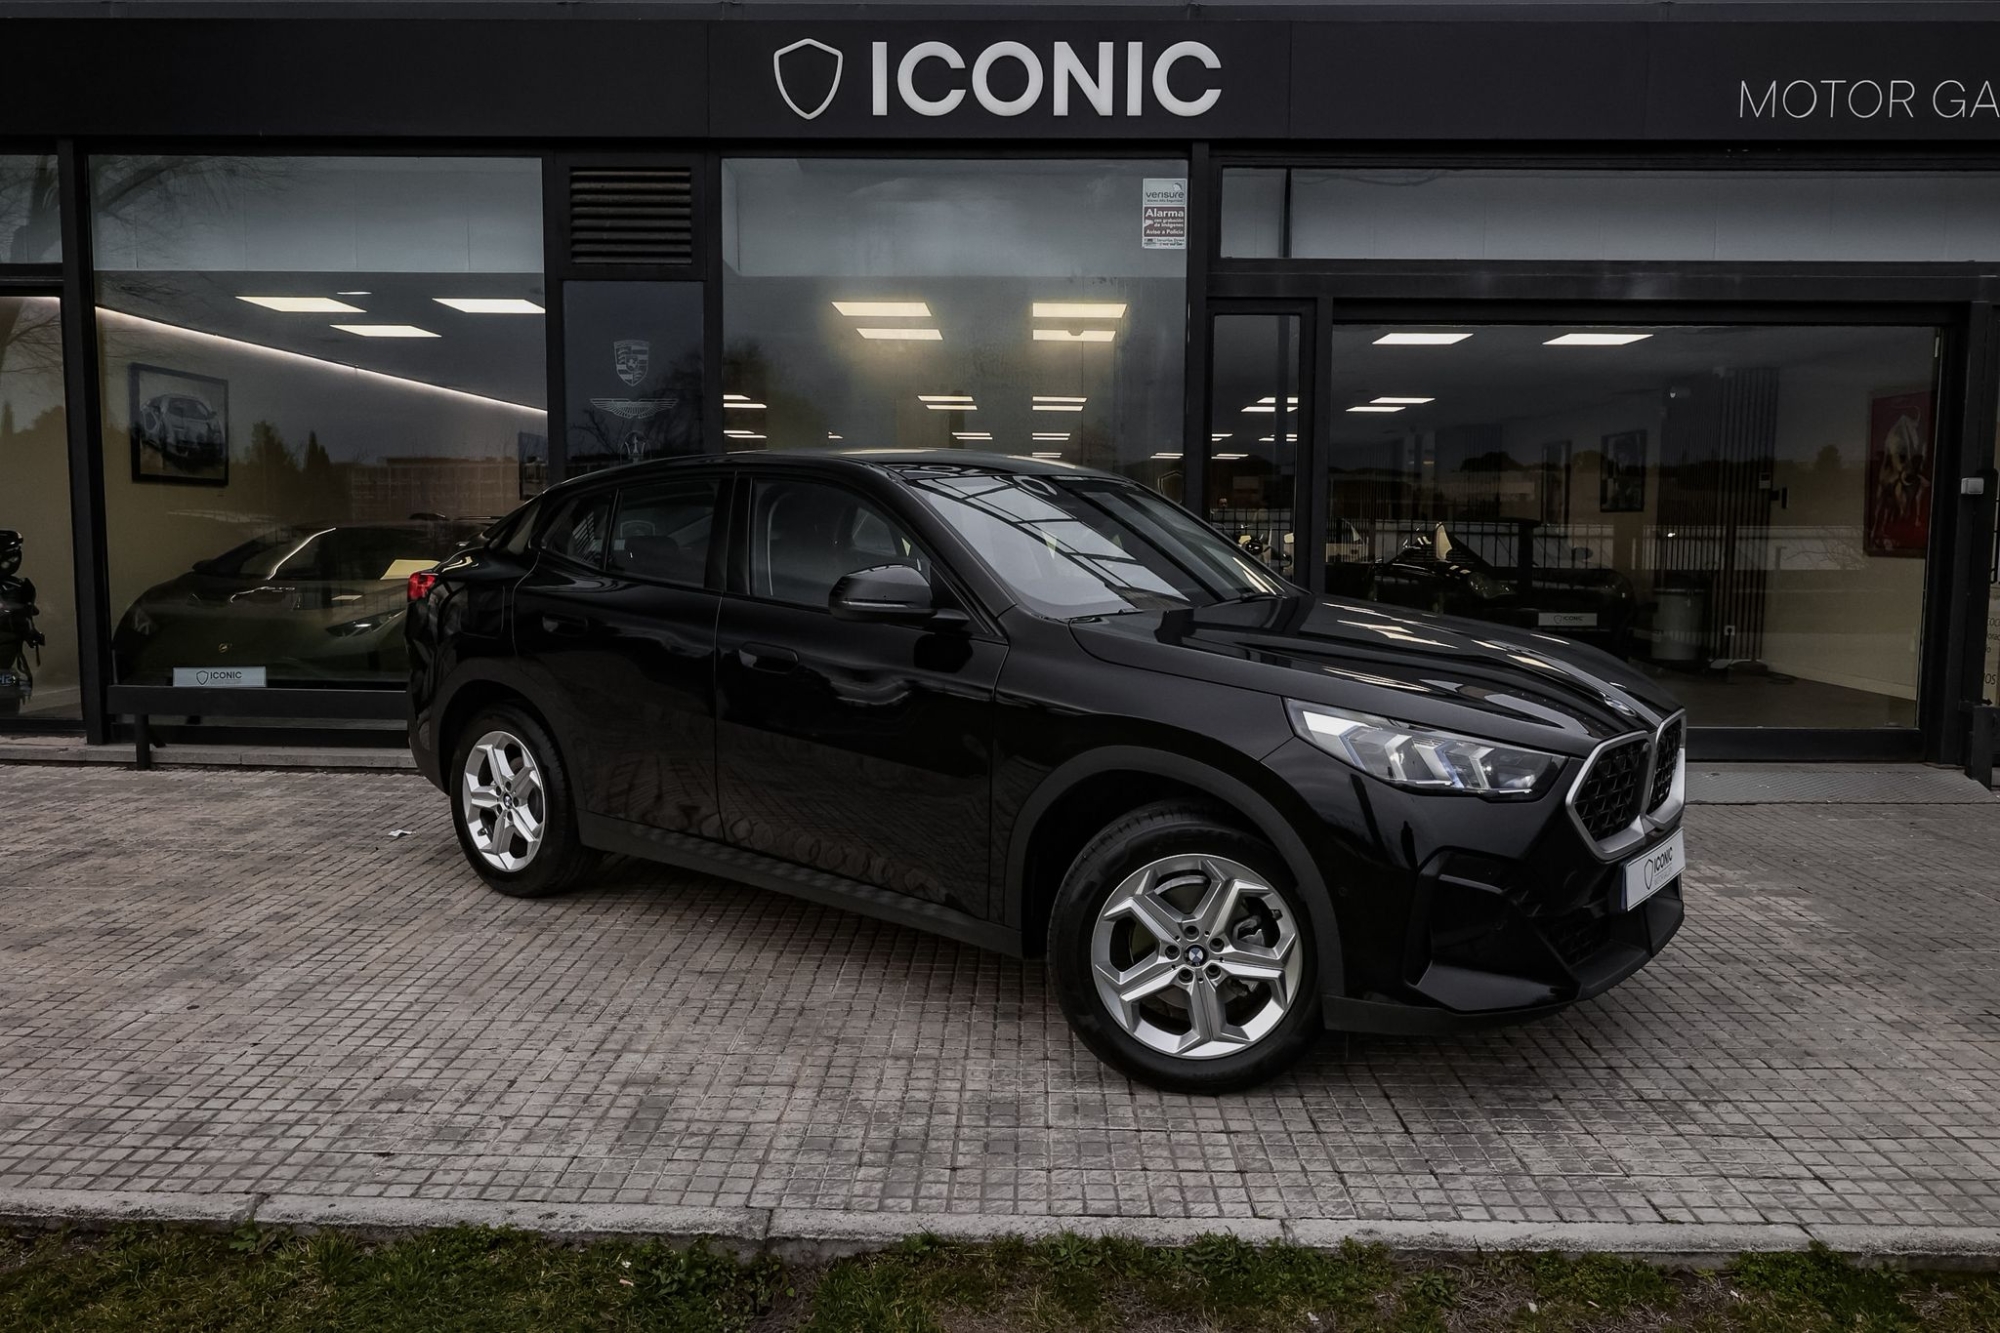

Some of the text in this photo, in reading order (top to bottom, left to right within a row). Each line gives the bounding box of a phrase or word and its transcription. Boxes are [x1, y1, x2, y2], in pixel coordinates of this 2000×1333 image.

[872, 41, 1222, 117] ICONIC
[1739, 80, 2000, 119] MOTOR GA
[1145, 191, 1185, 199] verisure
[1145, 208, 1184, 217] Alarma
[210, 671, 242, 679] ICONIC
[1654, 847, 1673, 873] ICONIC
